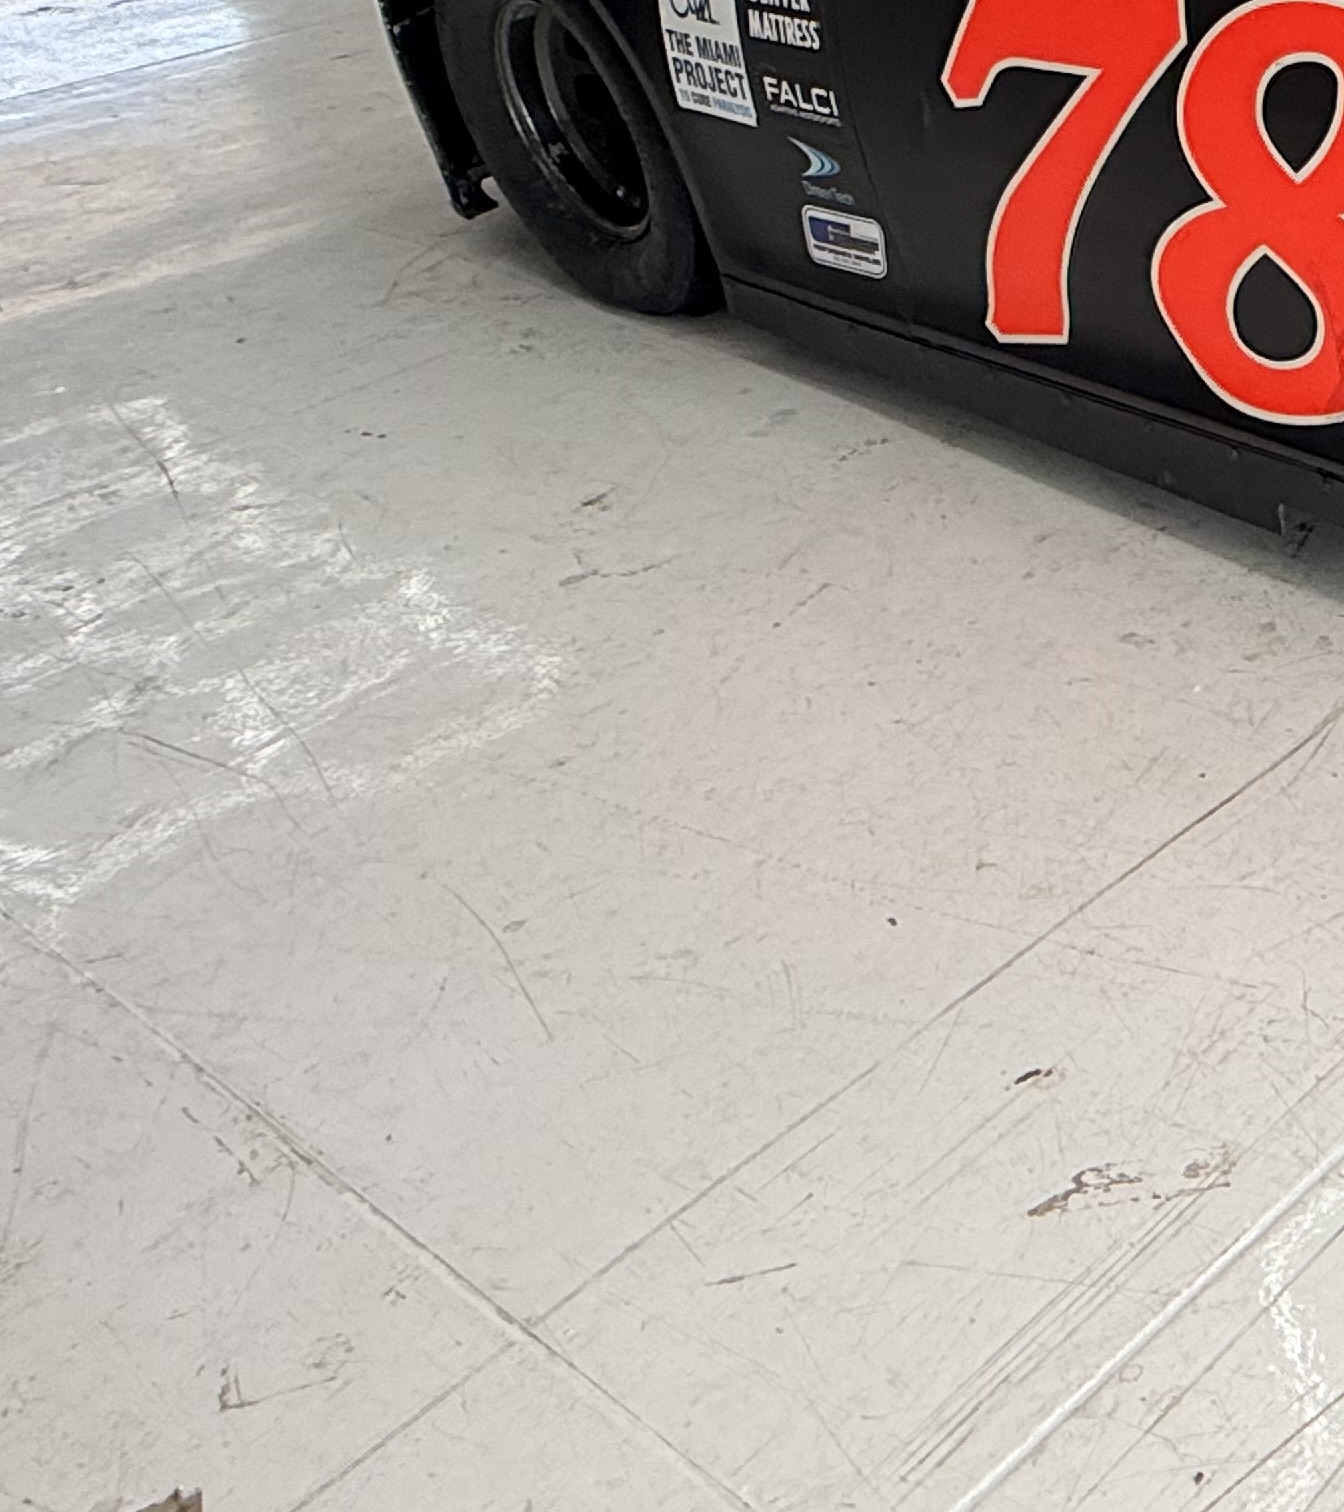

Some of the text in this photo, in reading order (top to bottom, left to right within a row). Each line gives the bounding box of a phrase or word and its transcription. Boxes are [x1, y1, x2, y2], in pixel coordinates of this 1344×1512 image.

[666, 29, 742, 68] THE MIAMI
[747, 9, 821, 50] MATTRESS
[672, 57, 747, 100] PROJECT
[762, 76, 840, 116] FALCI
